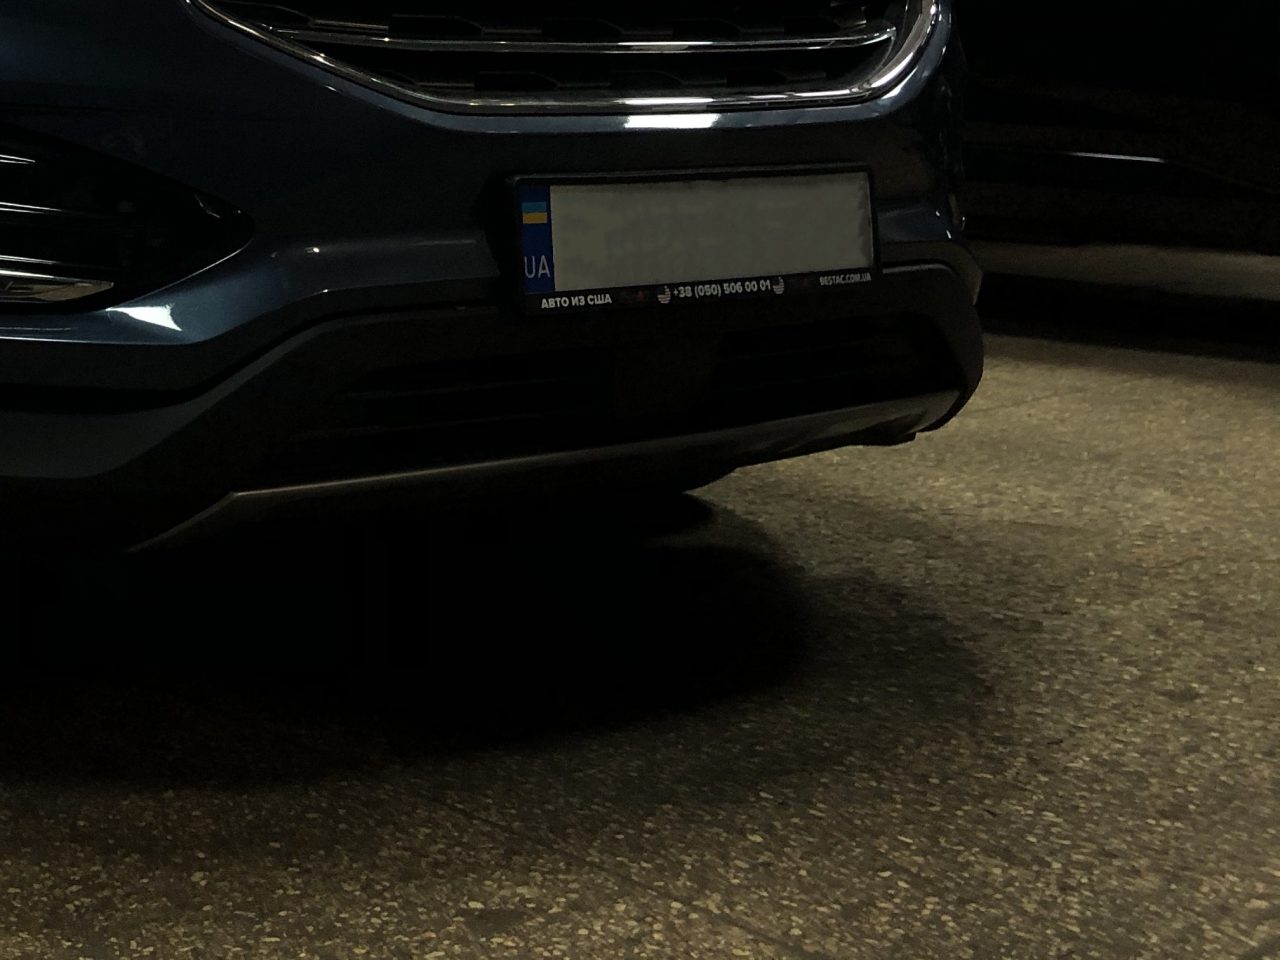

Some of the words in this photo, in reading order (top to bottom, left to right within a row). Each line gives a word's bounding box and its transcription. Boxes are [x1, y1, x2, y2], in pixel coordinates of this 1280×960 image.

[523, 255, 551, 279] UA
[673, 285, 692, 298] +38
[694, 283, 721, 299] (050)
[744, 280, 758, 292] 00
[541, 296, 570, 309] АВТО
[570, 295, 586, 307] ИЗ
[587, 293, 613, 305] США
